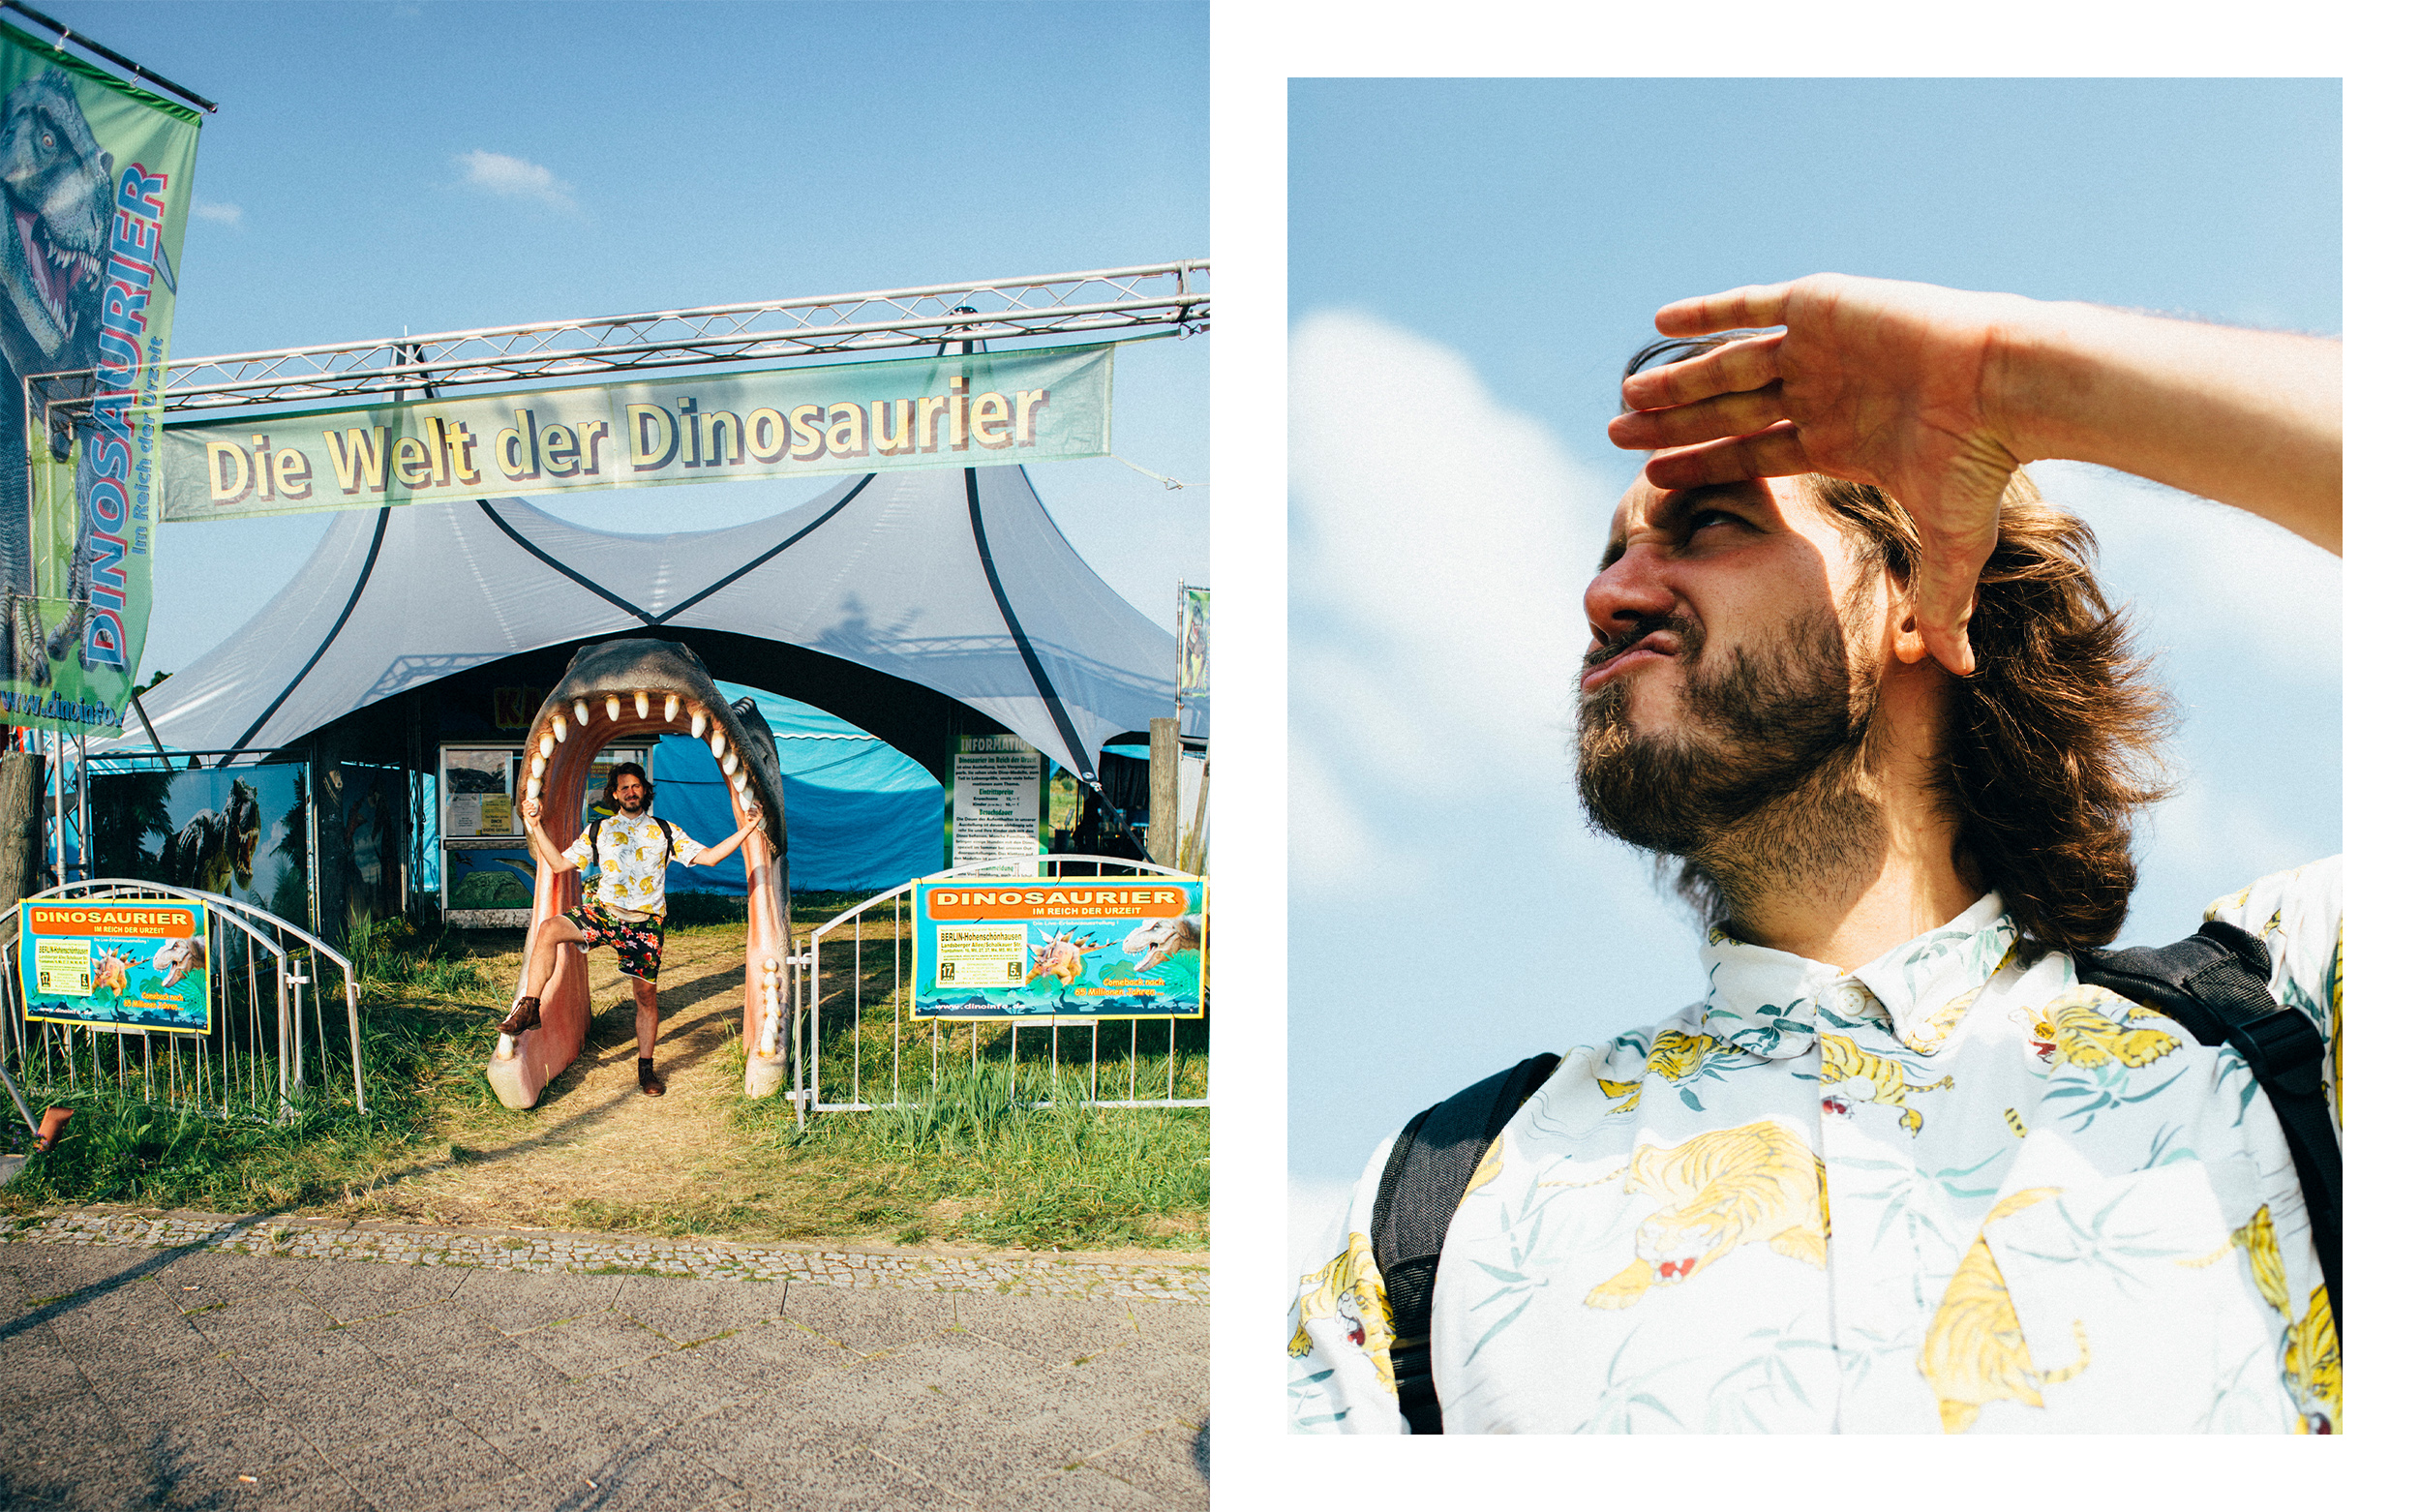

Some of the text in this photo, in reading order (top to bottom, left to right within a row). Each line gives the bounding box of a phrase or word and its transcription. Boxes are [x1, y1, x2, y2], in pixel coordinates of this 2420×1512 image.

[86, 162, 168, 668] DINOSAURIER
[132, 336, 164, 556] Im Reich der Urzeit
[205, 375, 1050, 505] Die Welt der Dinosaurier
[937, 892, 1177, 906] DINOSAURIER
[35, 911, 188, 925] DINOSAURIER
[940, 932, 1022, 941] BERLIN-Hohenschönhausen
[942, 966, 954, 977] 17.
[1010, 965, 1020, 976] 5.
[141, 991, 169, 1000] Comeback
[1088, 988, 1124, 996] Millionen
[132, 1000, 157, 1008] Millionen
[158, 1002, 178, 1010] Jahren
